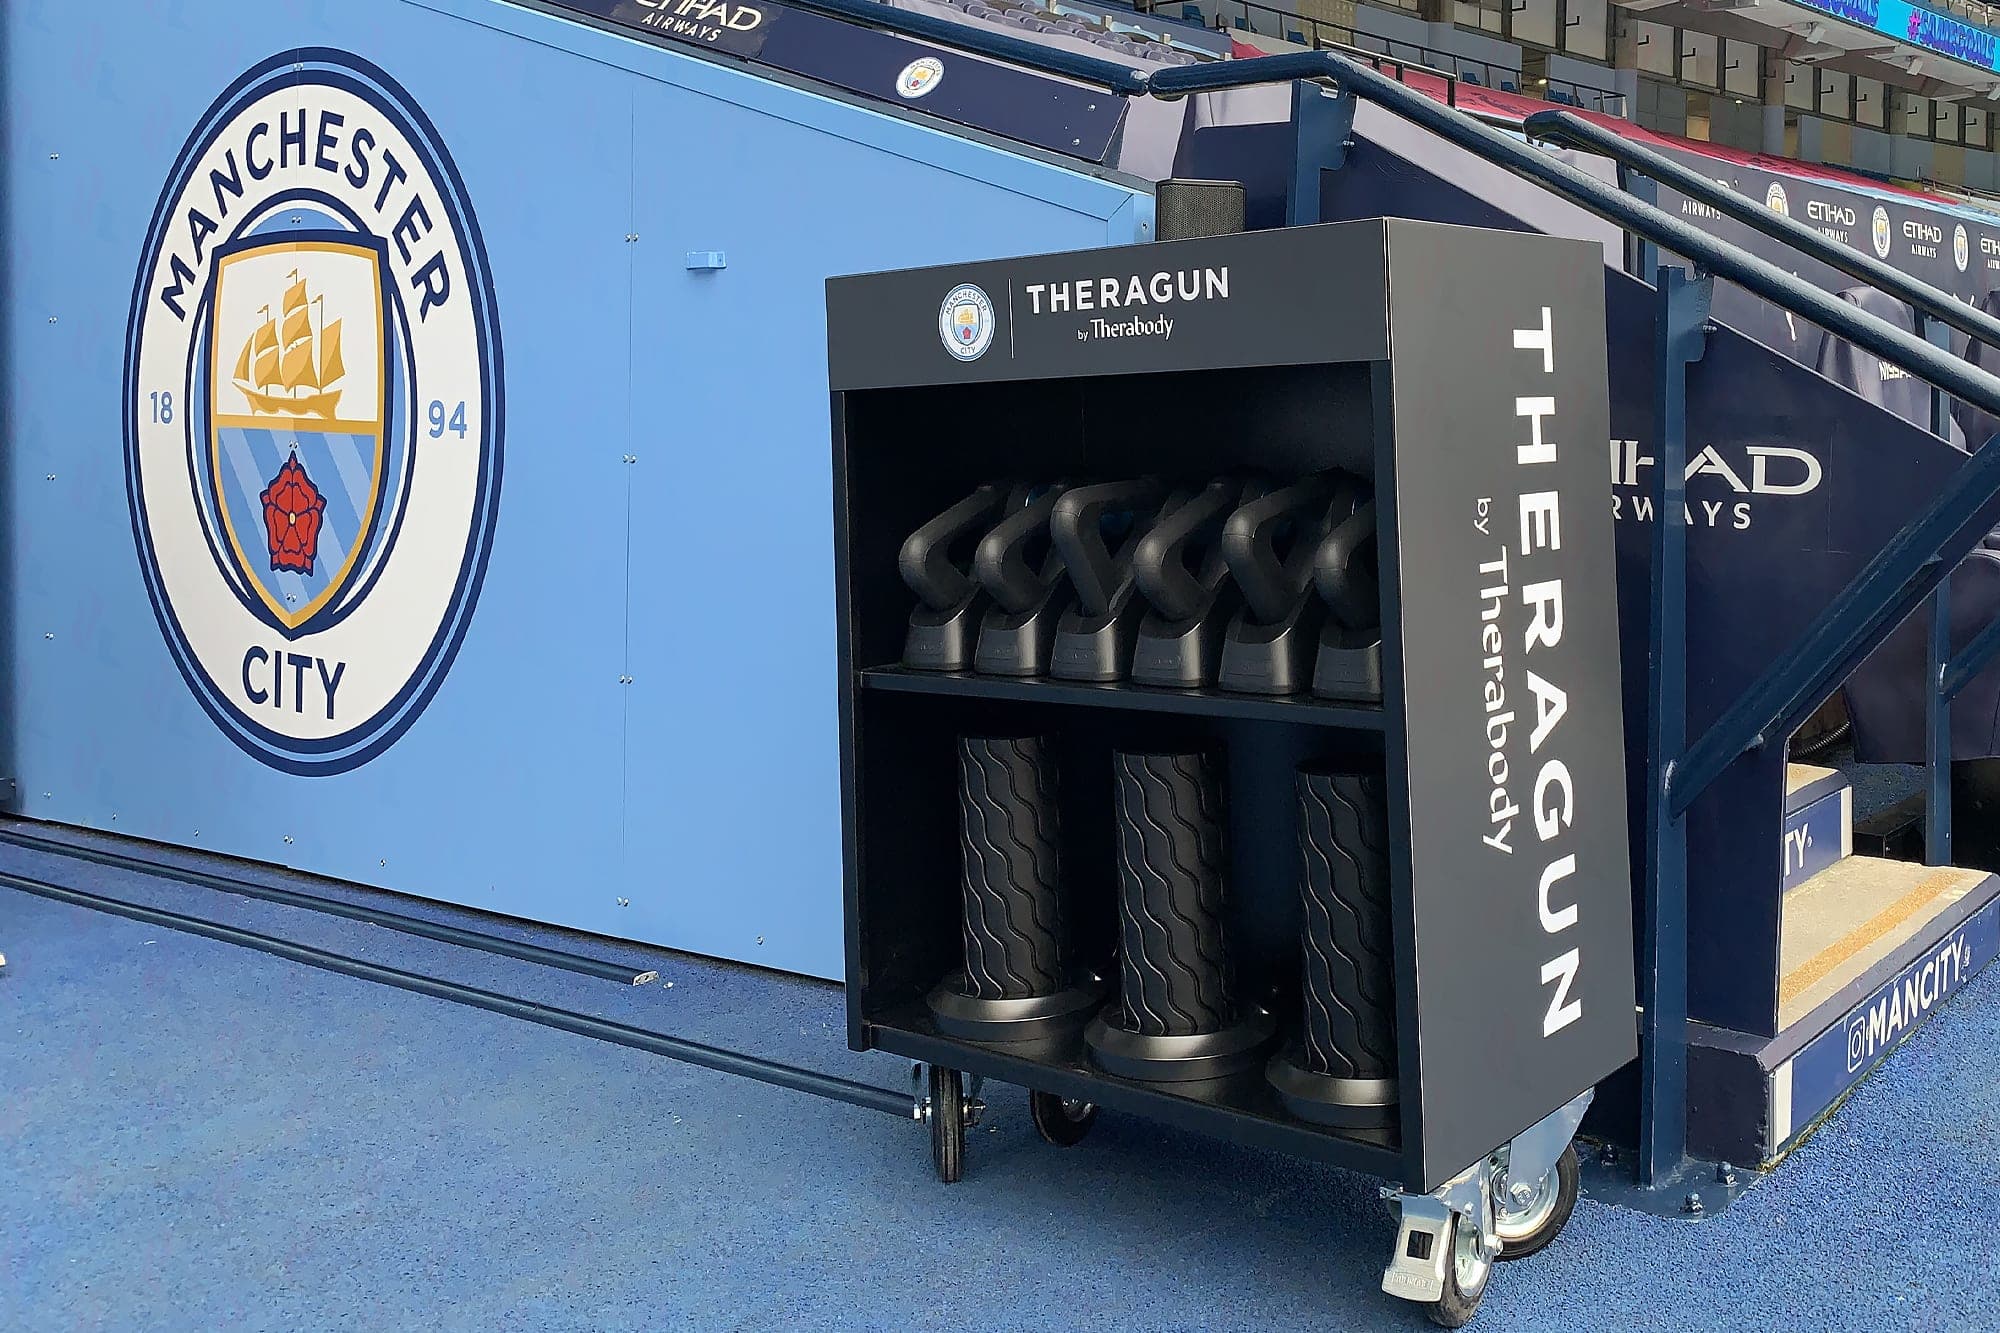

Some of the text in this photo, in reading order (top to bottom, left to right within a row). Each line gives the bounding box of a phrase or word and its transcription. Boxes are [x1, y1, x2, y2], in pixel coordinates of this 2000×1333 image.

[632, 0, 762, 31] IHAD
[642, 12, 721, 41] AIRWAYS
[161, 108, 451, 324] MANCHESTER
[1807, 201, 1856, 226] ETIHAD
[1903, 221, 1942, 243] ETIHAD
[946, 290, 987, 316] MANCHESTER
[1026, 266, 1230, 315] THERAGUN
[1077, 314, 1174, 342] by Therabody
[150, 391, 173, 424] 18
[429, 400, 468, 440] 94
[1610, 440, 1822, 496] IHAD
[241, 645, 346, 720] CITY
[1473, 497, 1520, 855] by Therabody
[1512, 306, 1582, 1039] THERAGUN
[1867, 933, 1965, 1057] MANCITY
